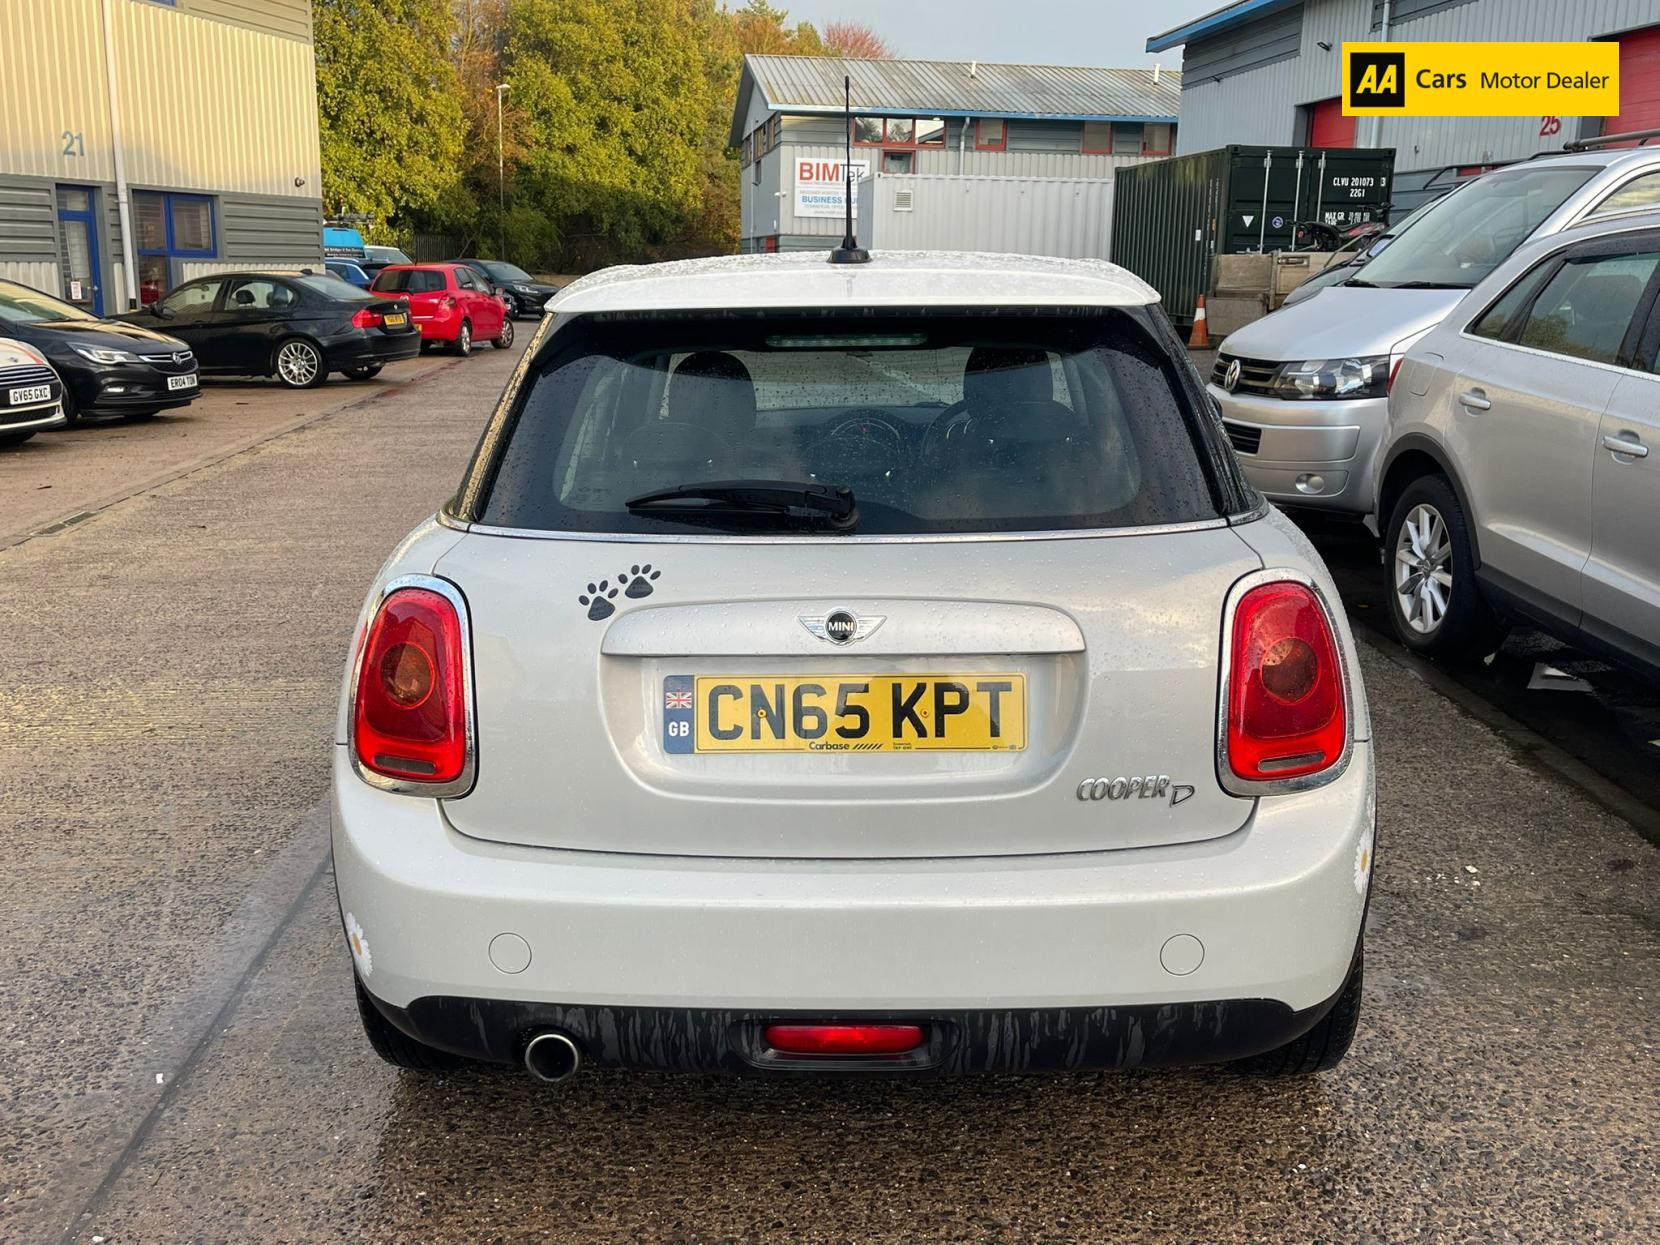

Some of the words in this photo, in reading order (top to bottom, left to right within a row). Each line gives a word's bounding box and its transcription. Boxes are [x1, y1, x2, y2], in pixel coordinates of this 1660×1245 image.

[1539, 116, 1562, 136] 25
[62, 130, 85, 157] 21
[1333, 177, 1349, 187] CLVU
[1351, 177, 1374, 187] 201073
[802, 195, 843, 204] BUSINESS
[13, 389, 33, 402] GV65
[34, 387, 48, 399] GXC
[828, 621, 854, 632] MINI
[708, 683, 870, 740] CN65
[892, 682, 1012, 739] KPT
[668, 721, 690, 737] GB
[809, 740, 850, 751] Carbase
[1076, 775, 1170, 802] COOPER
[1169, 784, 1195, 808] D
